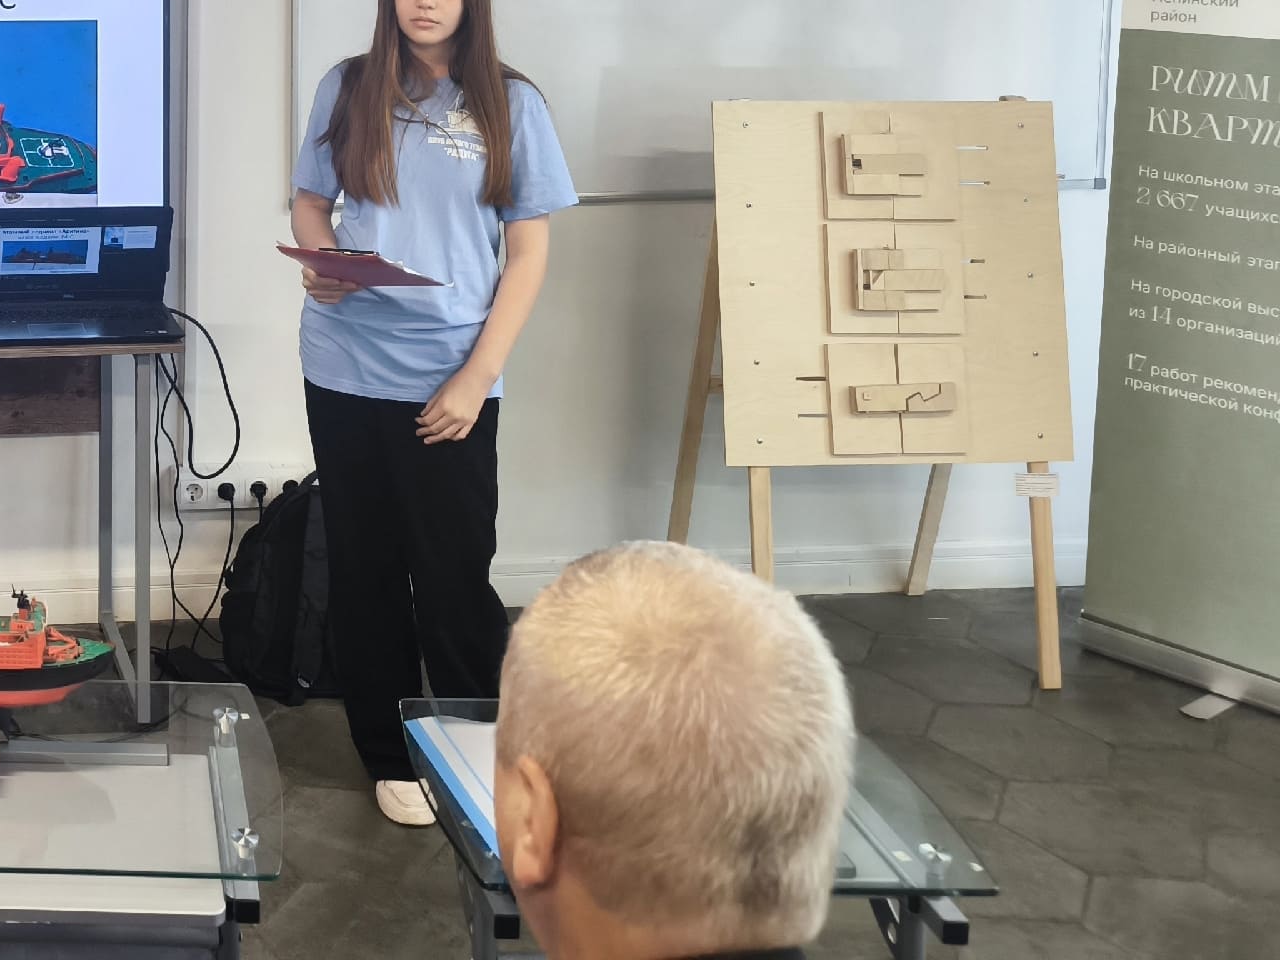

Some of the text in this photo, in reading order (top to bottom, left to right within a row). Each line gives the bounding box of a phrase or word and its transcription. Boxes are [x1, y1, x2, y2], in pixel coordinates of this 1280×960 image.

[1150, 10, 1197, 23] район
[1138, 165, 1159, 179] На
[1164, 168, 1248, 191] школьном
[1134, 235, 1154, 249] На
[1158, 240, 1241, 264] районный
[1131, 280, 1151, 293] На
[1155, 285, 1242, 310] городской
[1129, 307, 1145, 319] из
[1151, 305, 1171, 325] 14
[1127, 353, 1280, 403] 17 работ рекомен
[1124, 375, 1239, 411] практической
